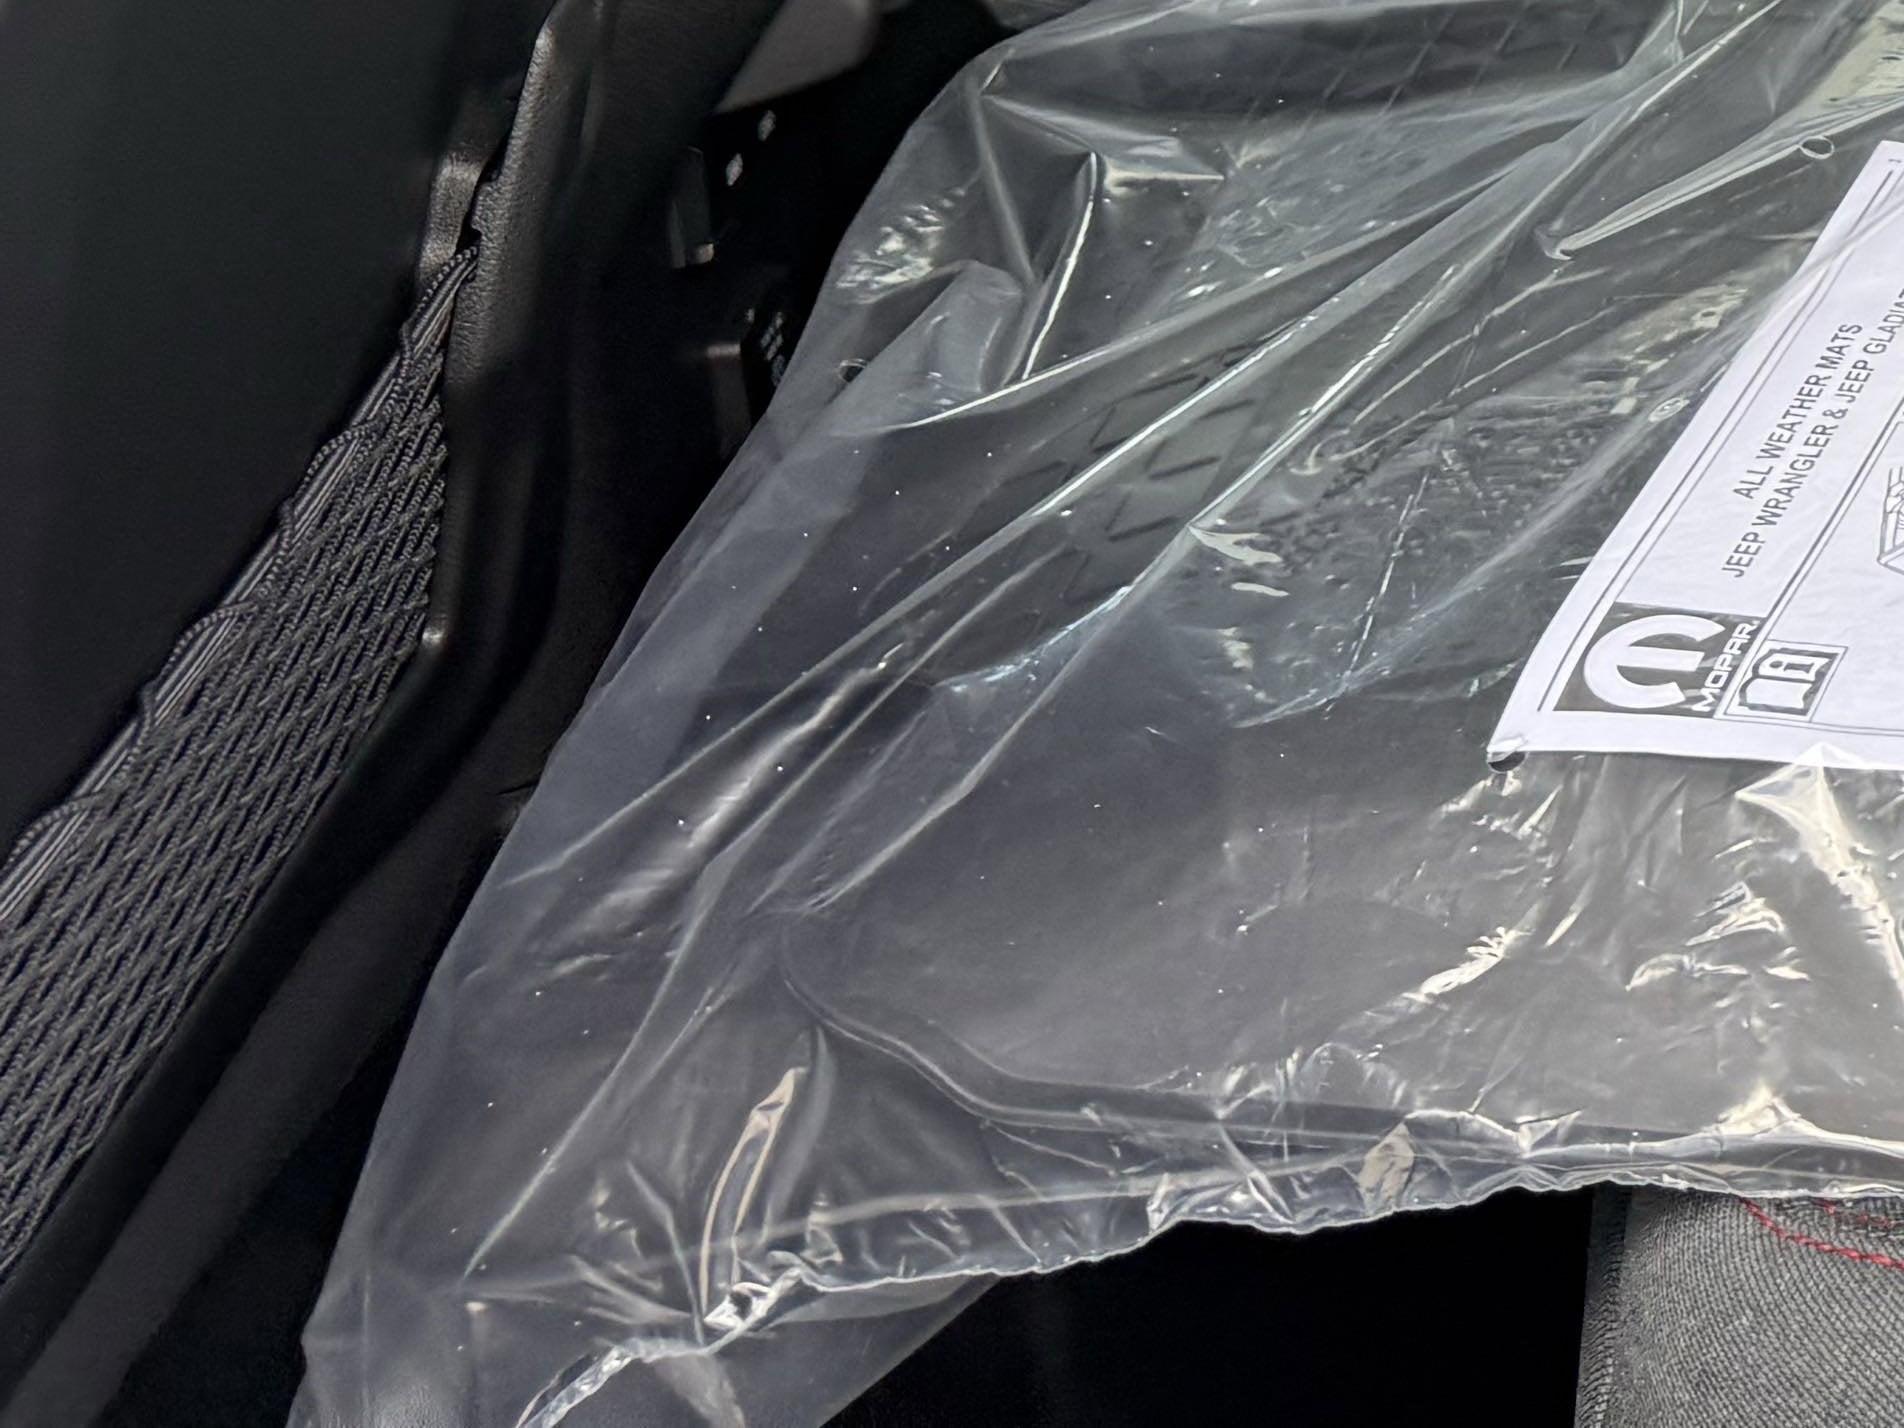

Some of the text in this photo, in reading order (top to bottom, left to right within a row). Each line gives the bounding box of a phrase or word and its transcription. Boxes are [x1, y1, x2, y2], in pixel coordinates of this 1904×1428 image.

[1732, 323, 1863, 499] ALL WEATHER MATS
[1822, 406, 1848, 420] &
[1833, 358, 1875, 404] JEEP
[1751, 423, 1839, 527] WRANGLER
[1721, 531, 1767, 578] JEEP
[1691, 622, 1757, 712] MOPAR
